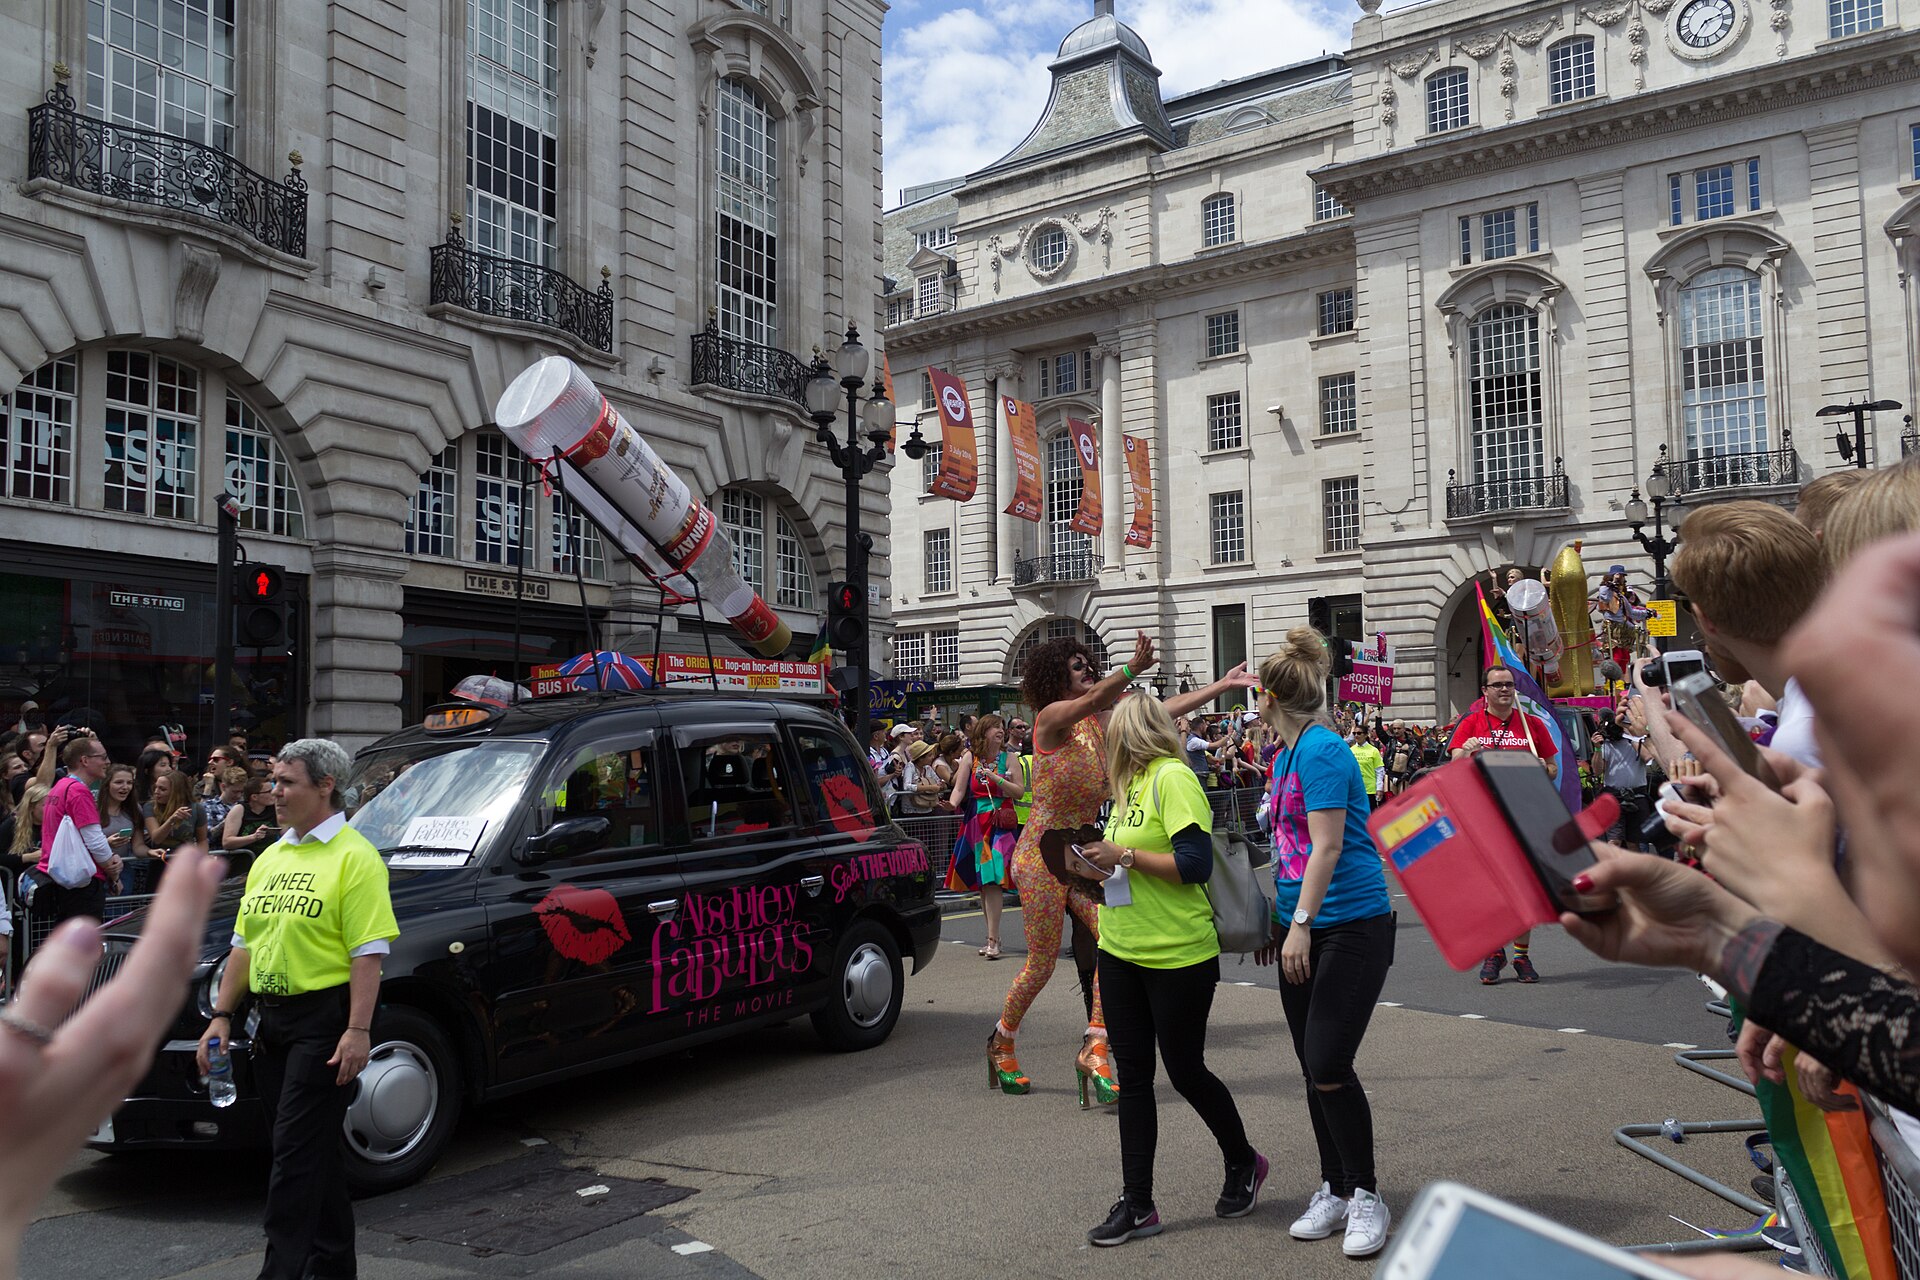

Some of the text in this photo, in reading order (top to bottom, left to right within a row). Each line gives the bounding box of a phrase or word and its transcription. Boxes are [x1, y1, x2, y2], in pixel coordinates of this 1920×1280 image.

[953, 447, 962, 458] July
[468, 575, 497, 589] THE
[501, 579, 547, 596] STING
[113, 594, 139, 605] THE
[142, 597, 182, 608] STING
[668, 655, 685, 669] The
[725, 660, 750, 672] hop-on
[752, 660, 779, 674] hop-off
[780, 663, 794, 675] BUS
[795, 664, 818, 676] TOURS
[749, 675, 778, 687] TICKETS
[1342, 673, 1391, 687] CROSSING
[537, 680, 562, 695] BUS
[1351, 683, 1380, 695] POINT
[938, 693, 980, 701] CREAM
[430, 710, 471, 728] TAXI
[1491, 730, 1515, 738] AREA
[1478, 737, 1529, 746] SUPERVISOR
[263, 872, 316, 893] WHEEL
[243, 894, 324, 919] STEWARD
[685, 989, 794, 1028] THE MOVIE
